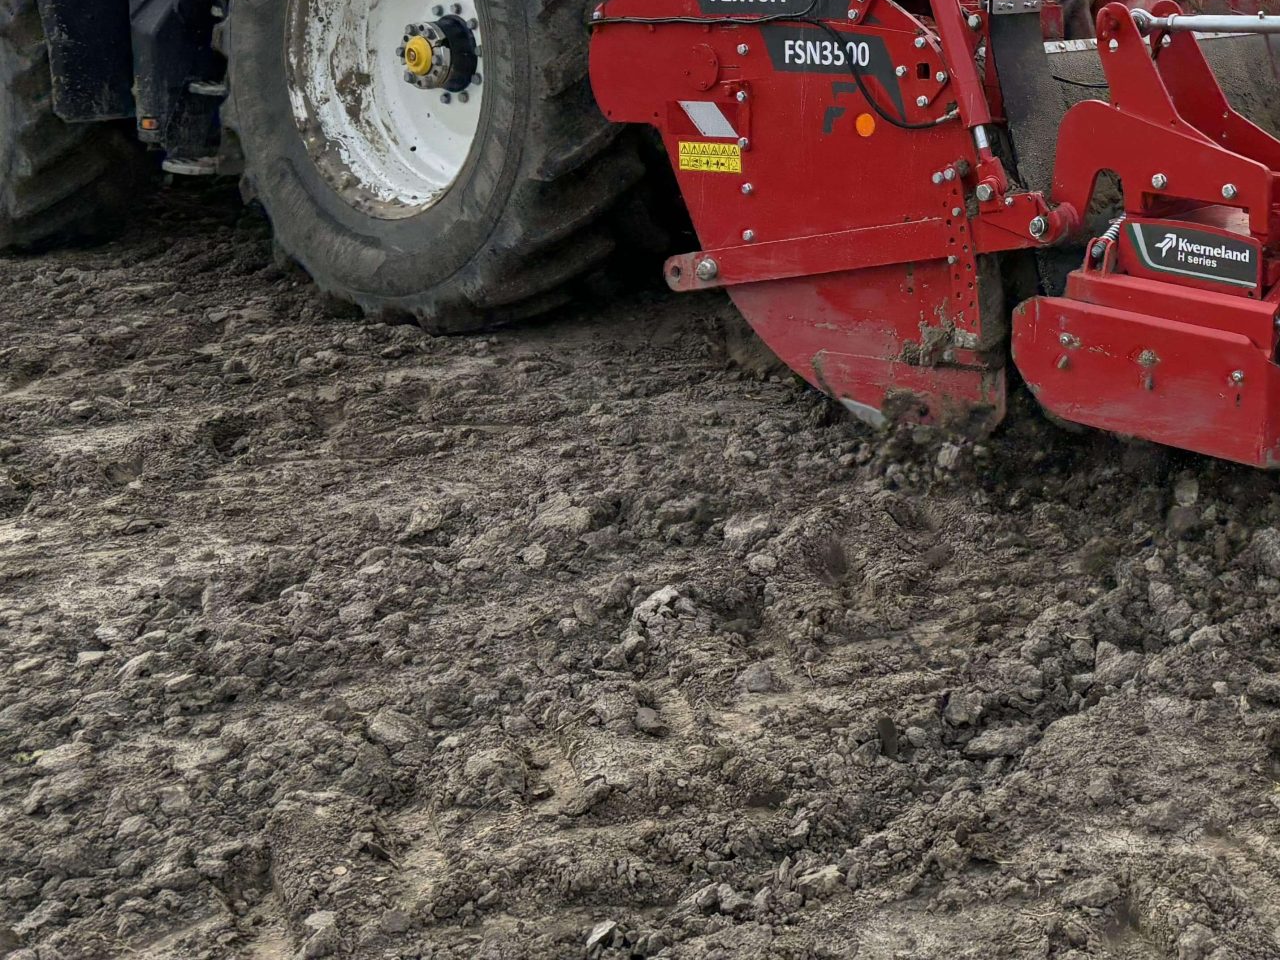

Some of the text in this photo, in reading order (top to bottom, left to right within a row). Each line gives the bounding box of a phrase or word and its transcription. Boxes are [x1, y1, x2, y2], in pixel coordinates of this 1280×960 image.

[1177, 251, 1217, 268] H series
[1178, 237, 1250, 263] Kverneland
